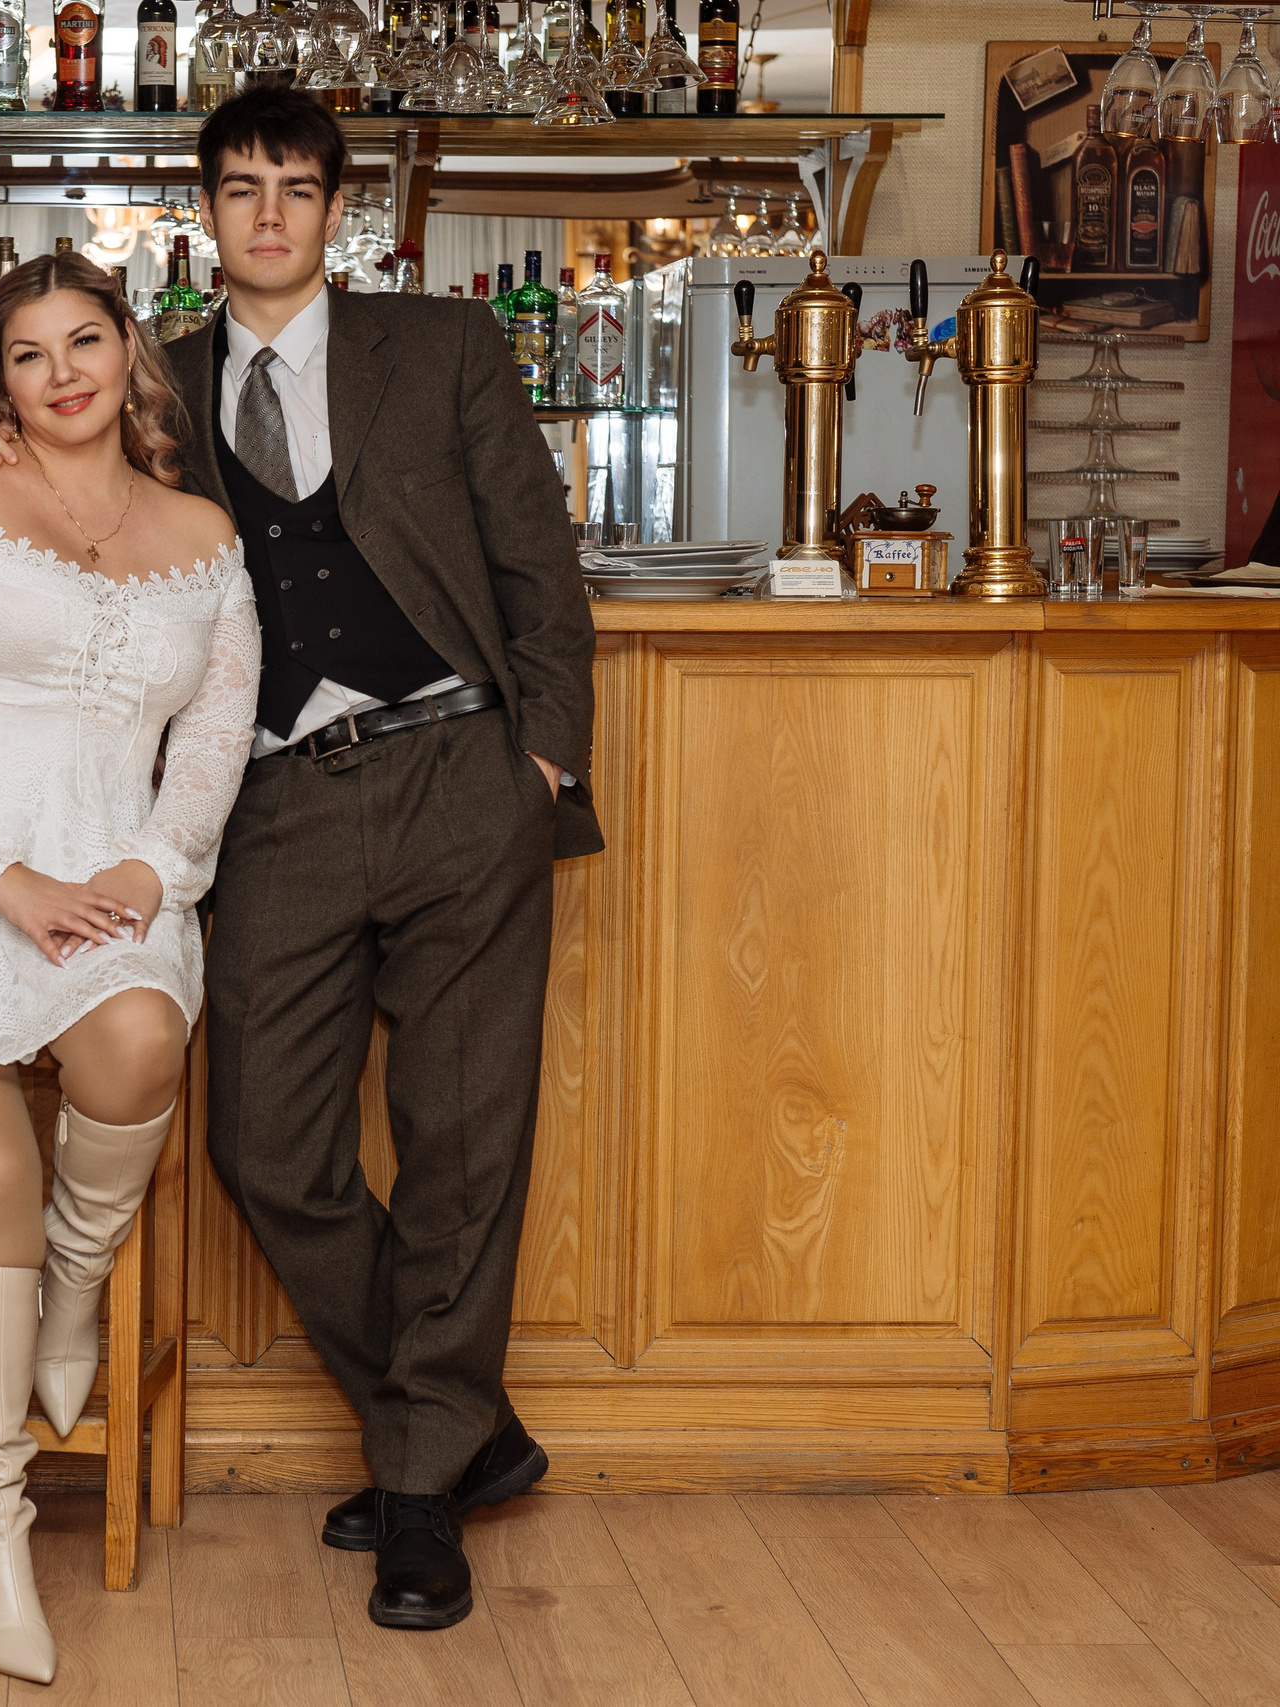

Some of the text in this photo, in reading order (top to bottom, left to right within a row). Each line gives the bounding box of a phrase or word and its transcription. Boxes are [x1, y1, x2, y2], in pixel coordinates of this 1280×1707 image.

[61, 20, 94, 28] MARTINI
[1088, 204, 1098, 212] 10
[585, 334, 619, 343] GILEY'S
[873, 549, 912, 559] Kaffee
